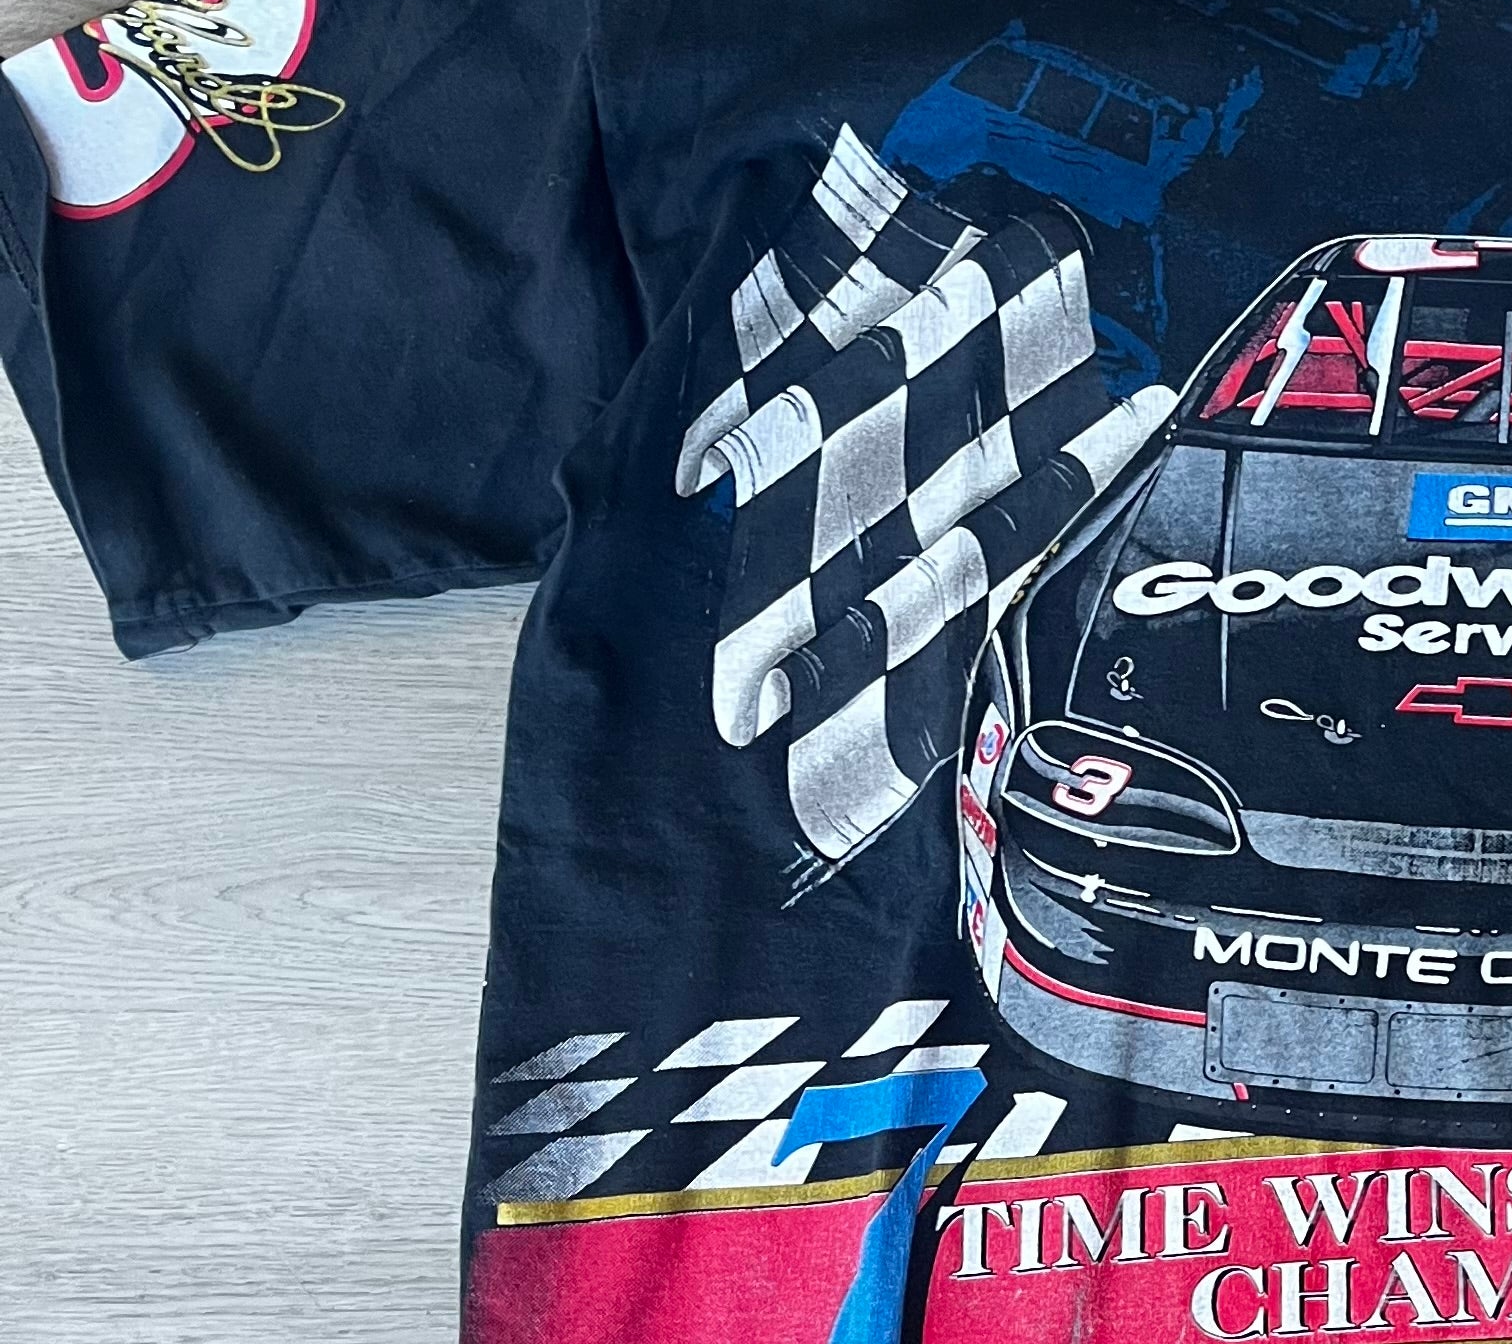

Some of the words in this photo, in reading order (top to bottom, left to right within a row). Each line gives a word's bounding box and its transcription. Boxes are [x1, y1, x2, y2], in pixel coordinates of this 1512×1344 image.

[1052, 755, 1132, 818] 3
[1193, 926, 1457, 985] MONTE
[935, 1180, 1232, 1280] TIME
